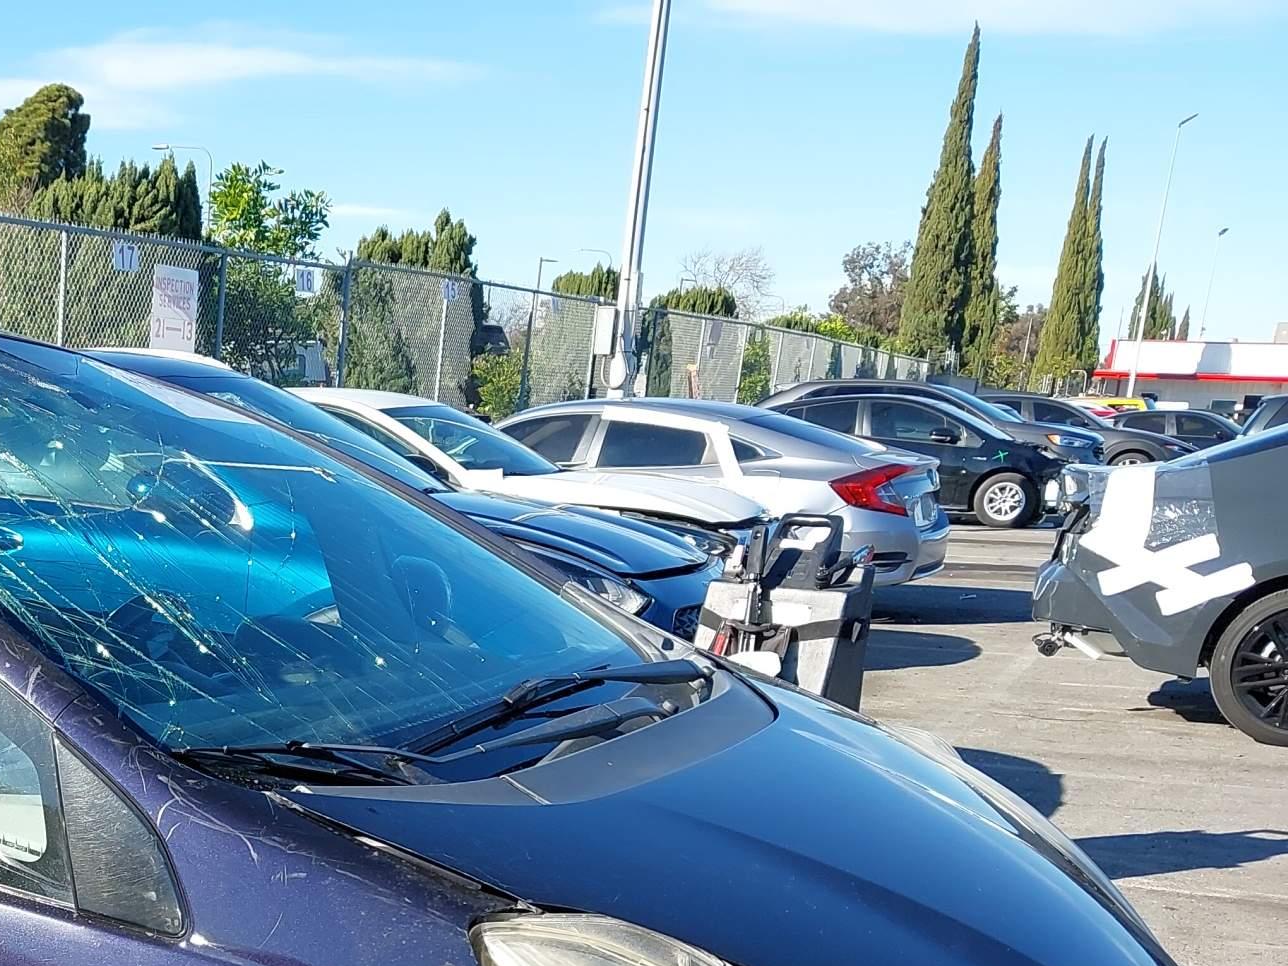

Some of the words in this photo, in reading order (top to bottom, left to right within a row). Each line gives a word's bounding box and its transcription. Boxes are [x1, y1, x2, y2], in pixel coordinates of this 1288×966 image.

[119, 245, 135, 269] 17
[156, 277, 194, 294] INSPECTION
[300, 271, 312, 291] 16
[445, 281, 456, 299] 15
[159, 294, 191, 310] SERVICES
